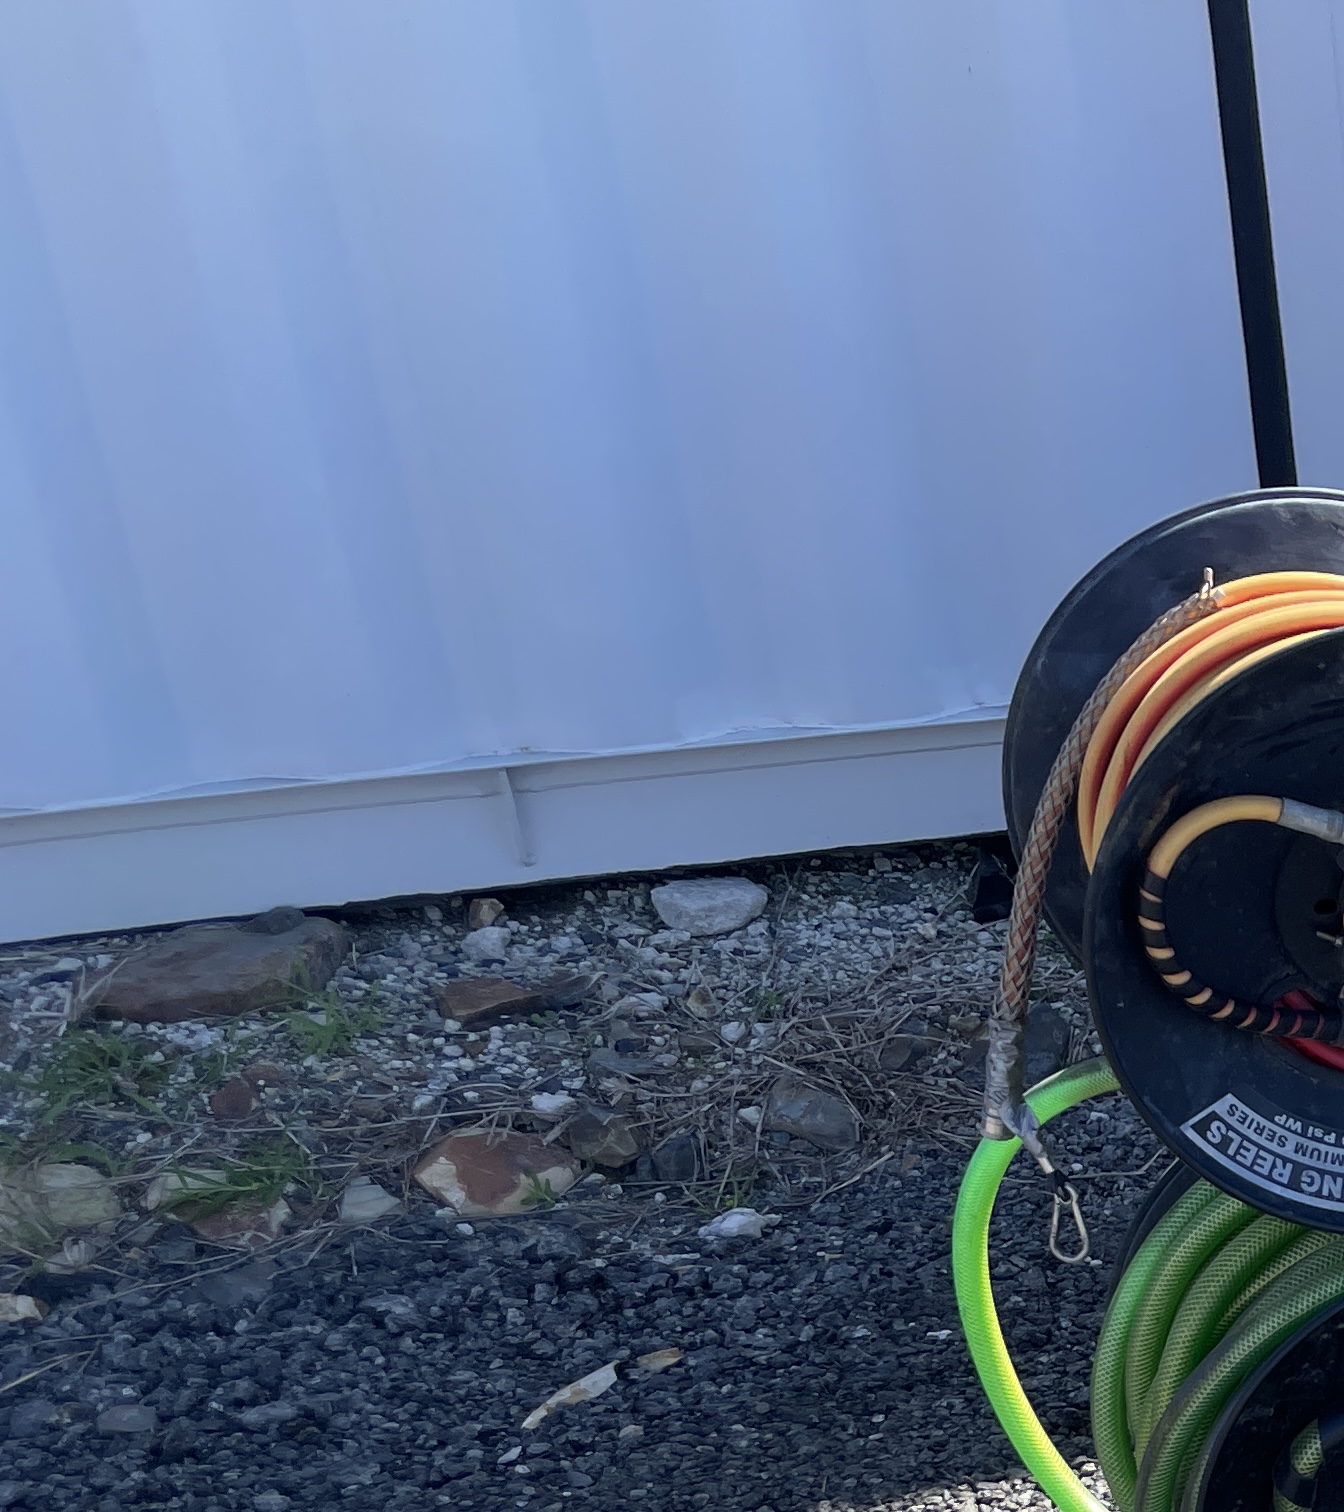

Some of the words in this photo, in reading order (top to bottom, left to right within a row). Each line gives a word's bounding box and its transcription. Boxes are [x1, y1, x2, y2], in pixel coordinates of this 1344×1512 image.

[1226, 1102, 1289, 1148] SERIES
[1273, 1112, 1303, 1133] WP
[1307, 1126, 1337, 1143] Psi
[1205, 1120, 1293, 1184] REELS
